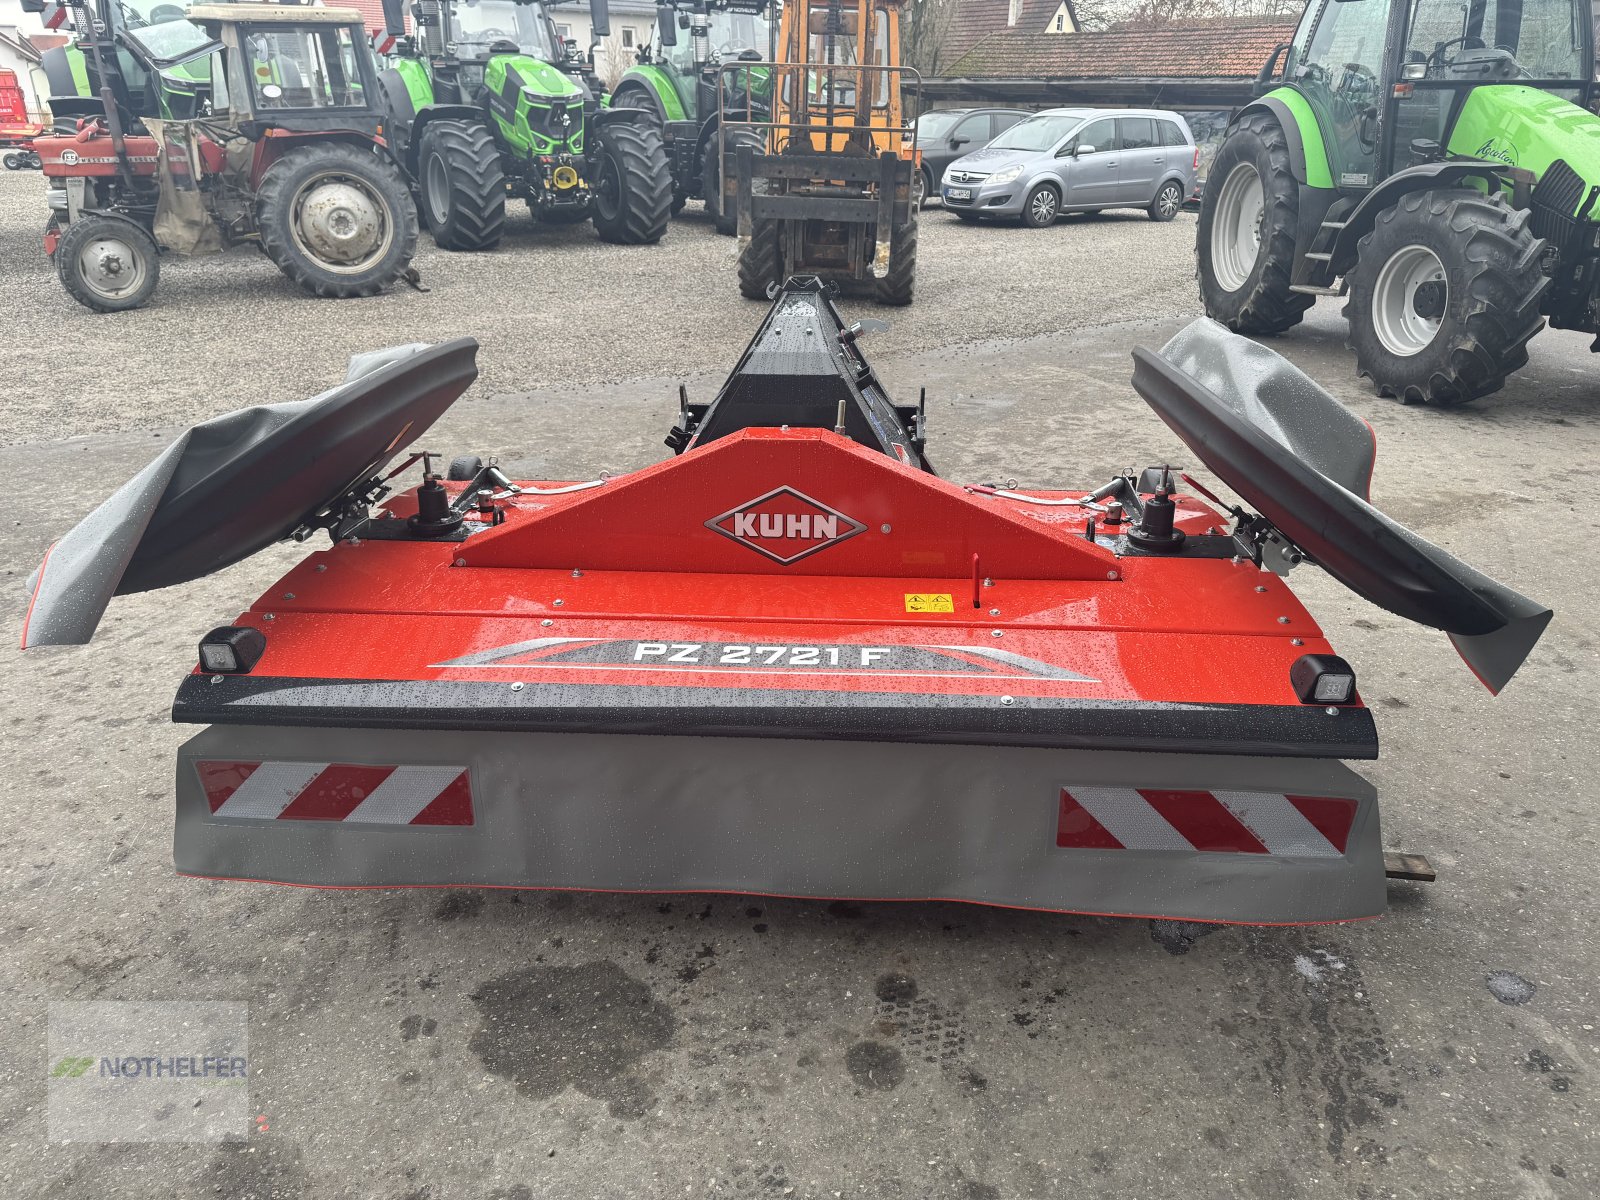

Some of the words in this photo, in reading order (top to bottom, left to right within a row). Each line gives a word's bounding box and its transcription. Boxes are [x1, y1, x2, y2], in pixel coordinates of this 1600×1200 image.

[734, 512, 838, 540] KUHN
[633, 643, 703, 663] PZ
[719, 645, 840, 666] 2721
[861, 648, 891, 666] F
